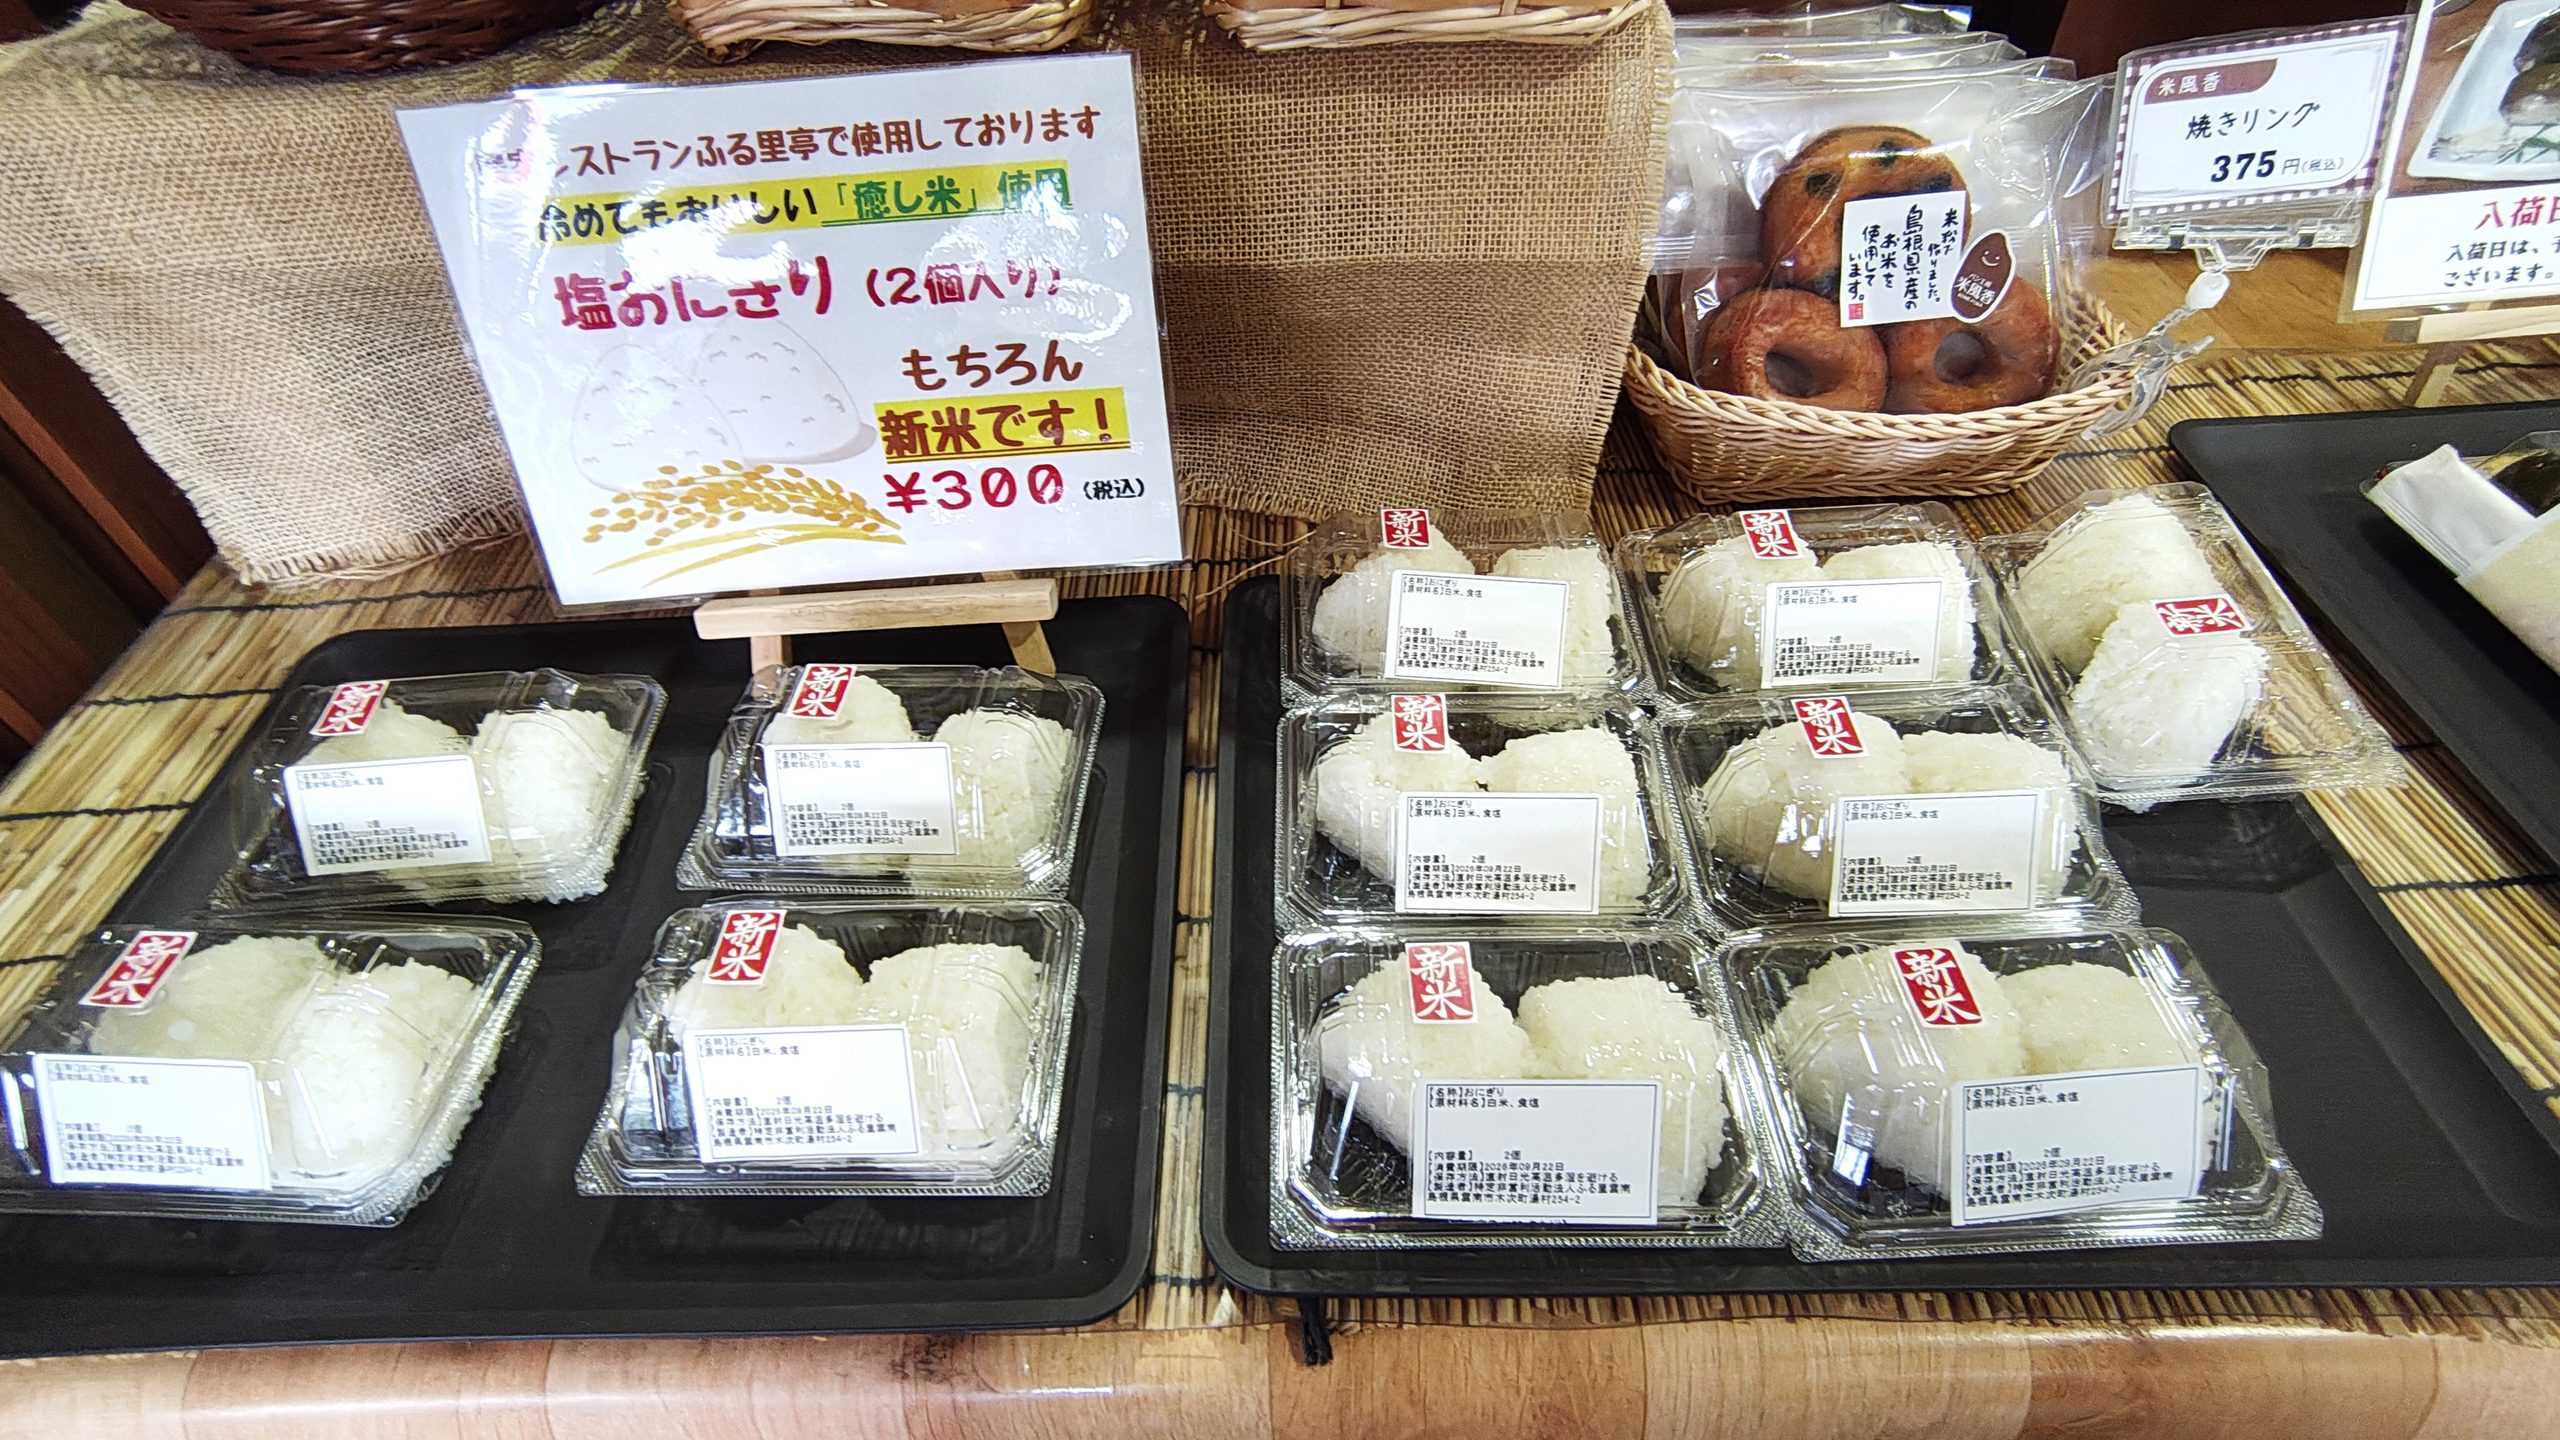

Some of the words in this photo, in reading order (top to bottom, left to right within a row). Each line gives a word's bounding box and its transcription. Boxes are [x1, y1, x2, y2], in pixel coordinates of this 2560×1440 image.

[2158, 71, 2222, 96] 米風香
[2184, 102, 2321, 141] 焼きリング
[1848, 253, 1865, 301] います。
[1863, 224, 1882, 286] 使用して
[1880, 233, 1901, 288] お米を
[1903, 203, 1924, 310] 島根県産の
[2444, 263, 2554, 287] ございます。
[902, 339, 1083, 391] もちろん
[879, 397, 1112, 456] 新米です!
[883, 463, 1063, 513] ¥300
[1083, 477, 1145, 500] (税込)
[1385, 511, 1429, 546] 新米
[1745, 511, 1799, 556] 新米
[2157, 598, 2245, 633] 新米
[317, 683, 381, 732] 新米
[792, 665, 851, 716] 新米
[1394, 694, 1445, 750] 新米
[1800, 699, 1864, 753] 新米
[89, 935, 186, 1003] 新米
[708, 912, 776, 980] 新米
[1410, 944, 1473, 1019] 新米
[1901, 948, 1982, 1024] 新米
[1429, 1088, 1504, 1096] 【名称】おにぎり
[1428, 1151, 1473, 1160] 【内容量】
[1504, 1151, 1521, 1160] 2個
